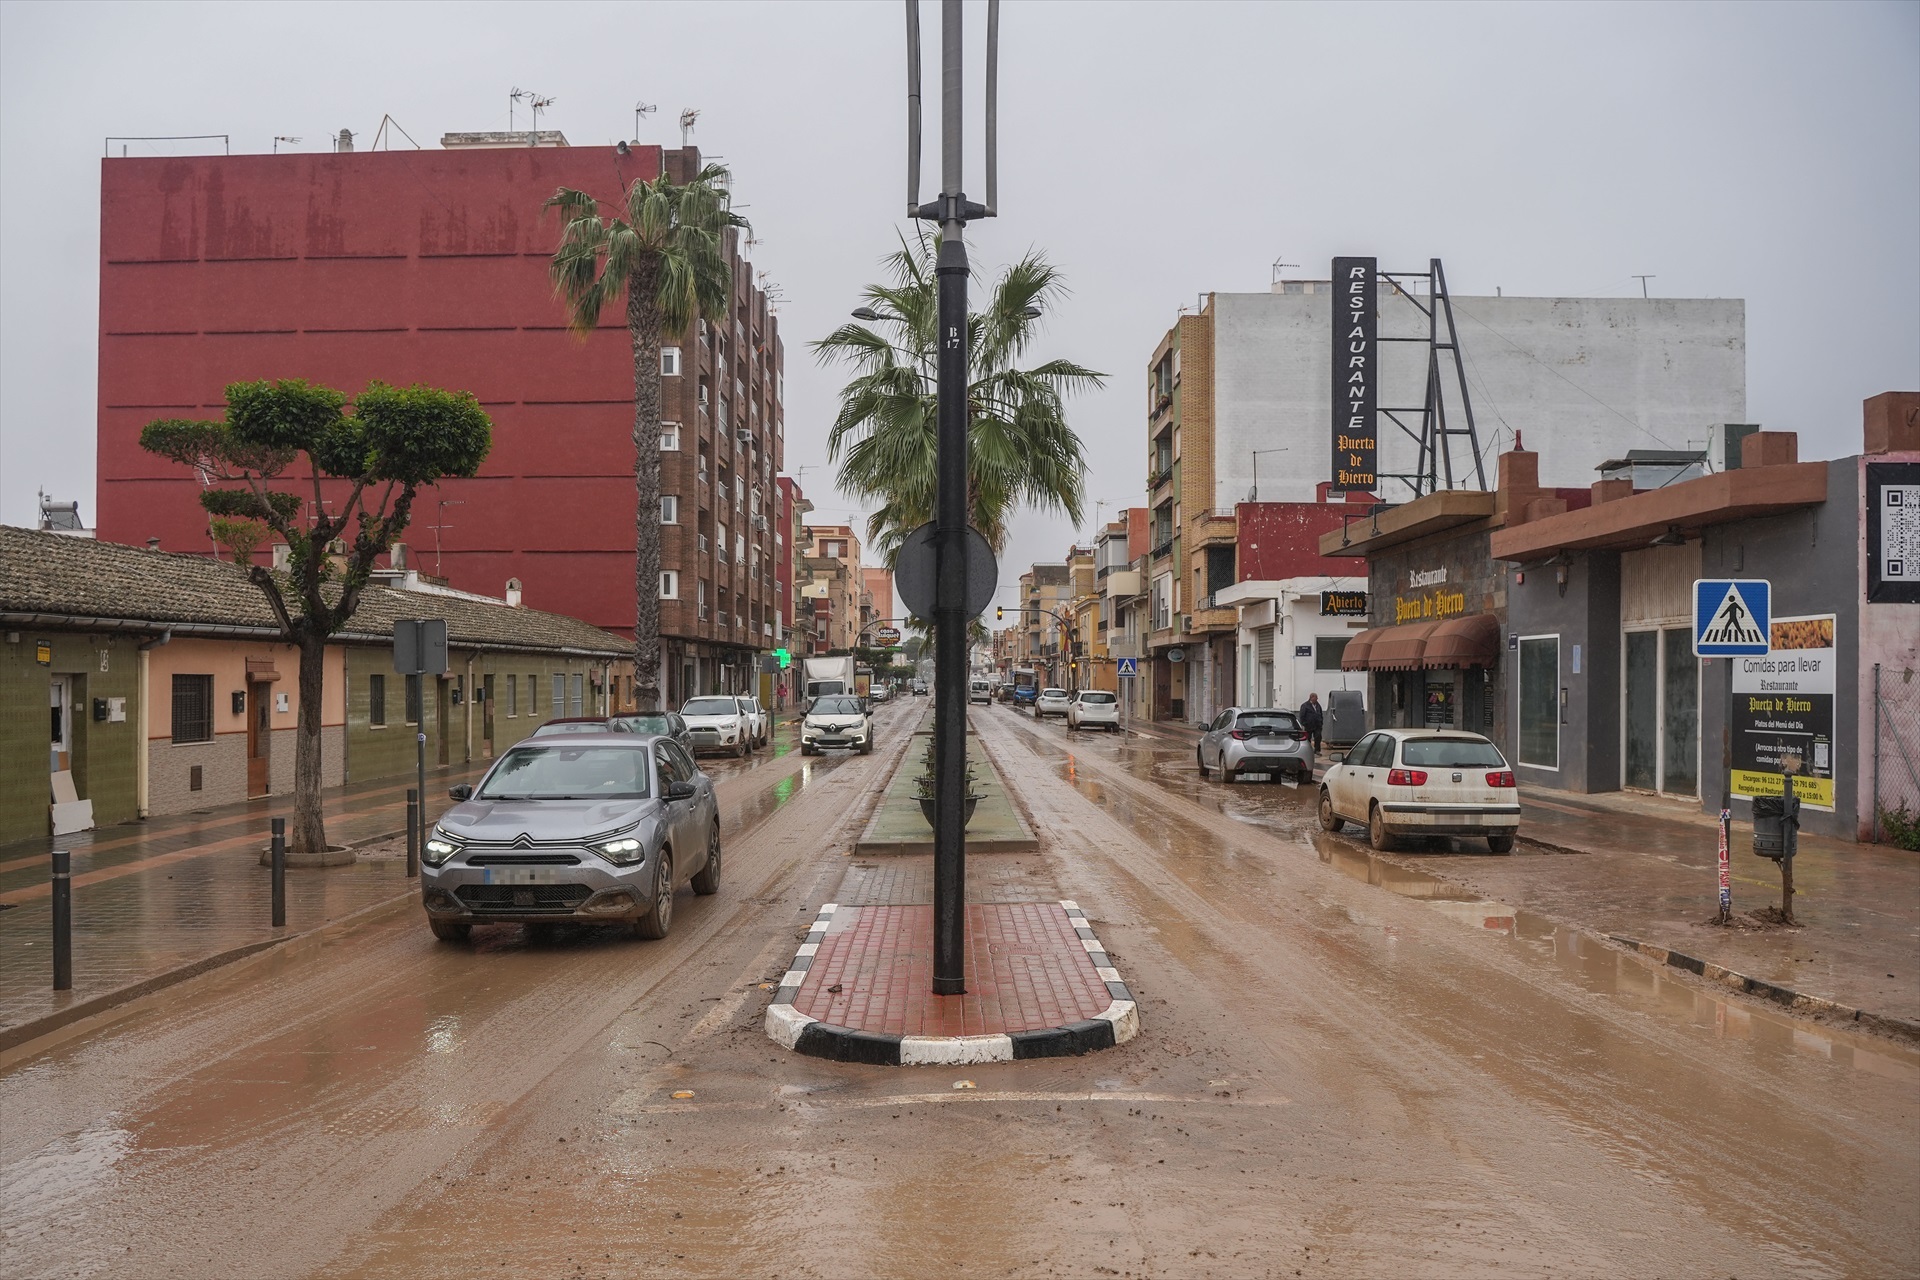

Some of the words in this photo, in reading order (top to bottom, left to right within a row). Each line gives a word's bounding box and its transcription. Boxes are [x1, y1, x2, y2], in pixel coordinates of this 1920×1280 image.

[950, 326, 958, 338] B
[946, 338, 960, 348] 17
[1348, 266, 1366, 428] RESTAURANTE
[1338, 434, 1375, 451] Puerta
[1350, 454, 1362, 467] de
[1338, 469, 1374, 486] Hierro
[1410, 564, 1448, 588] Restaurante
[1326, 594, 1362, 612] Abierto
[1396, 597, 1421, 624] Puerta
[1424, 593, 1432, 617] de
[1436, 589, 1464, 620] Hierro
[1744, 658, 1776, 673] Comidas
[1778, 660, 1796, 675] para
[1798, 657, 1821, 672] llevar
[1760, 680, 1798, 690] Restaurante
[1749, 697, 1772, 712] Puerta
[1775, 698, 1784, 712] de
[1786, 697, 1811, 713] Hierro
[1743, 775, 1761, 783] Encargos:
